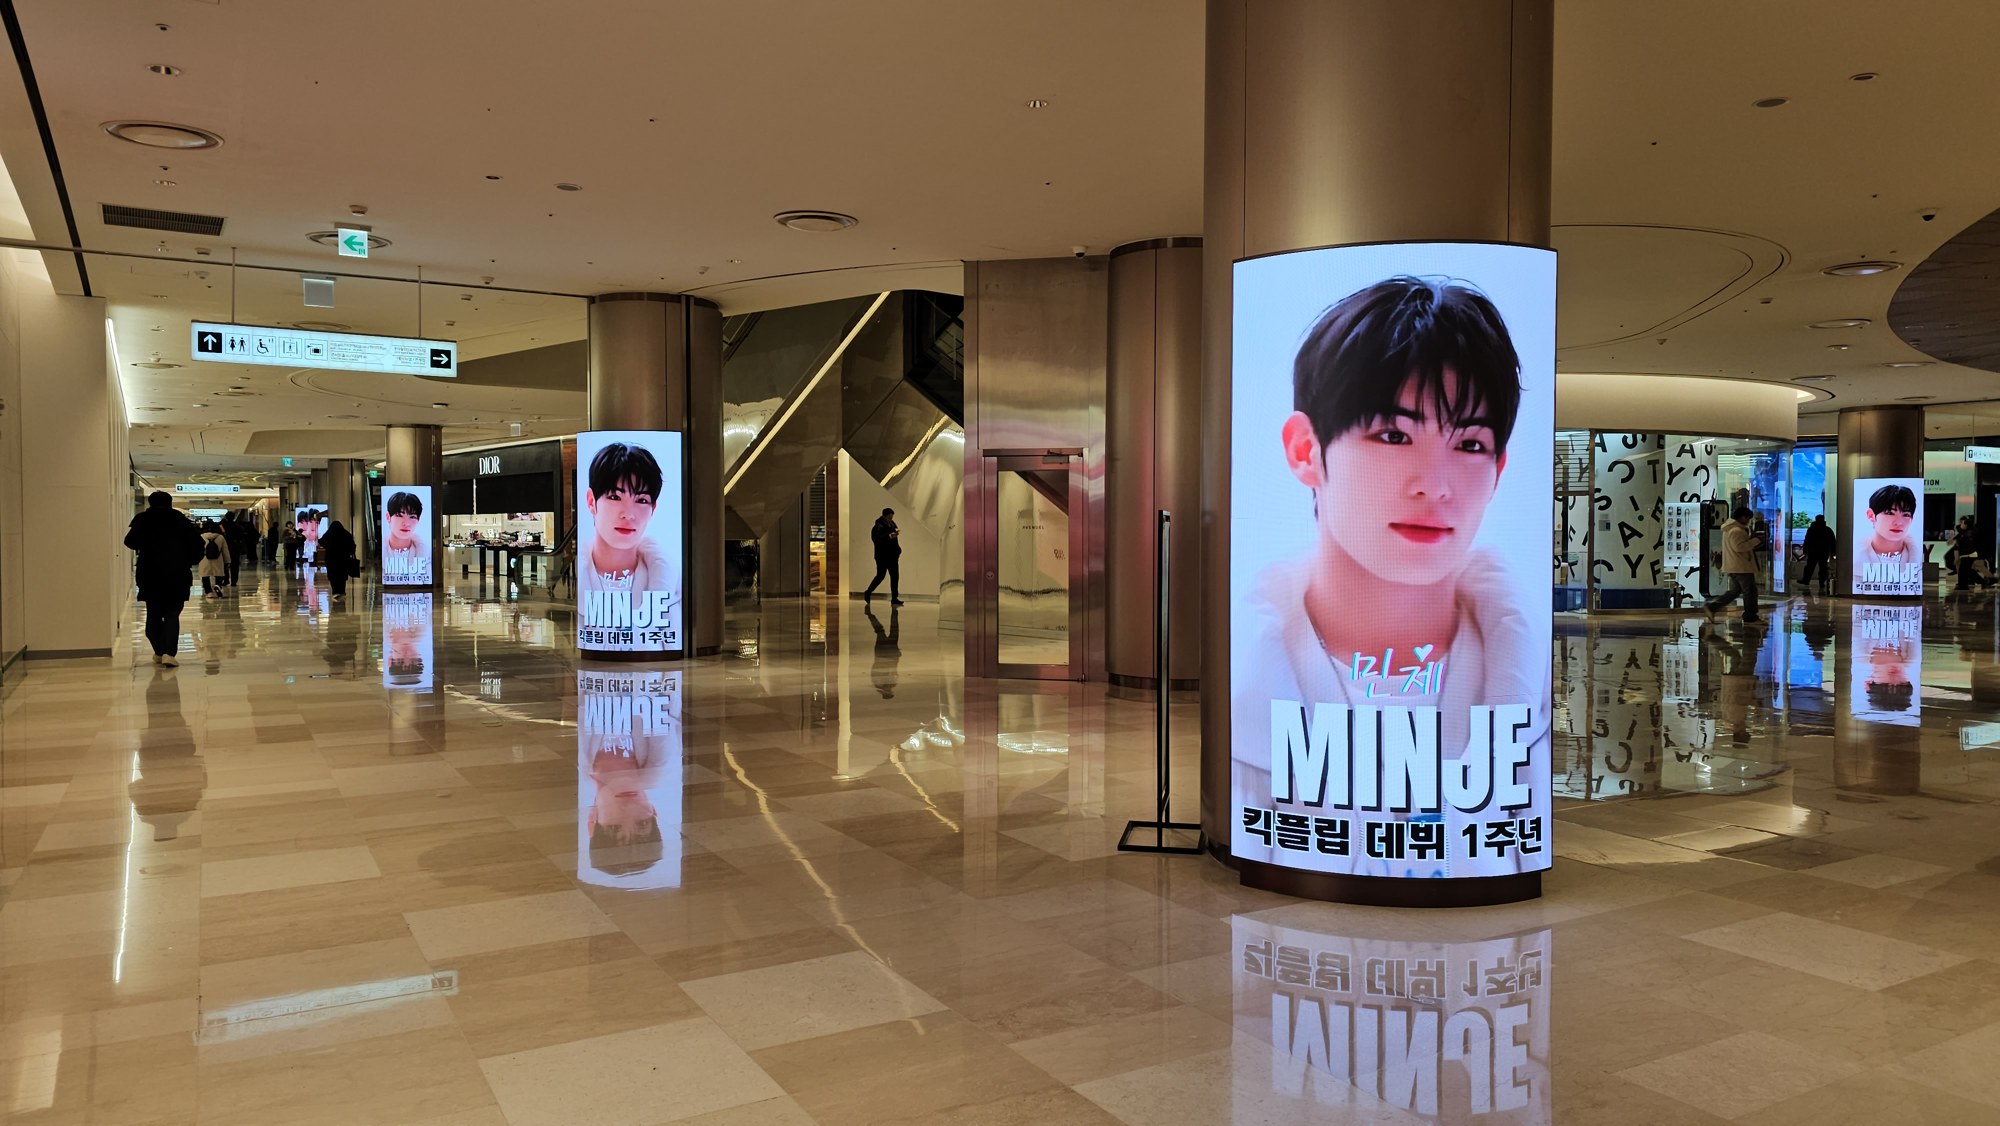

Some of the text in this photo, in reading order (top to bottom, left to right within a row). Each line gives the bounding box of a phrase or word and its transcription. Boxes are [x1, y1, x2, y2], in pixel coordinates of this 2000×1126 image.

[479, 455, 500, 475] DIOR
[384, 557, 427, 575] MINJE
[1862, 562, 1919, 585] MINJE
[584, 590, 671, 631] MINJE
[608, 631, 634, 645] 데뷔
[639, 631, 677, 645] 1주년
[1352, 646, 1447, 698] 민제
[1270, 699, 1532, 813] MINJE
[1242, 806, 1543, 861] 킥플립 데뷔 1주년
